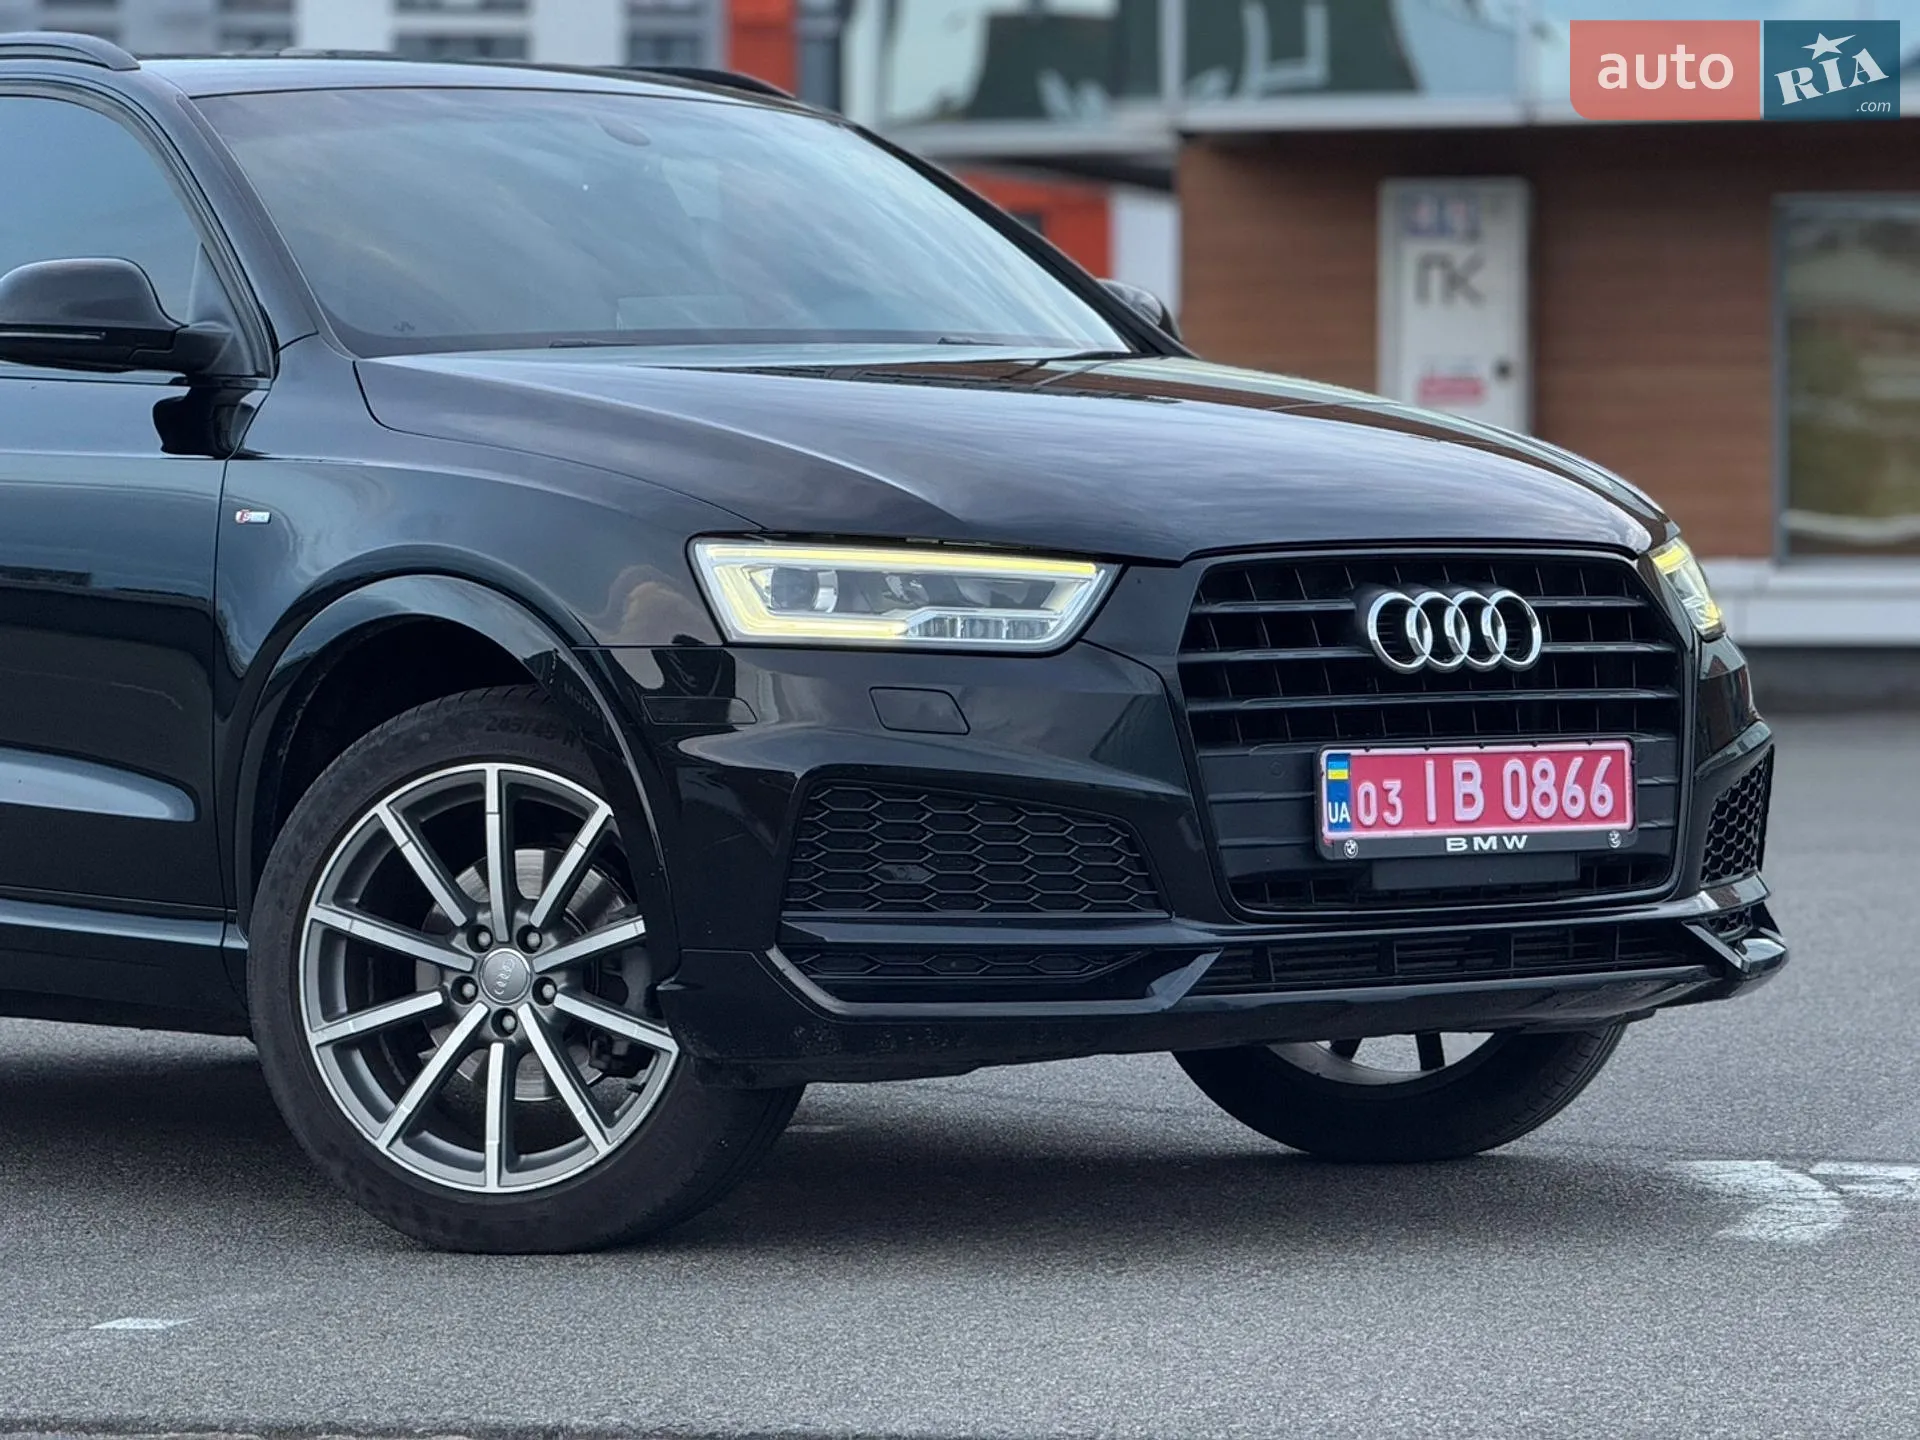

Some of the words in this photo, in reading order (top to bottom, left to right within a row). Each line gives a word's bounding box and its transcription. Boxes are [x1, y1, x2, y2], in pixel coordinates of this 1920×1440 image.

[1357, 779, 1402, 827] 03
[1502, 756, 1613, 820] 0866
[1328, 804, 1351, 823] UA
[1446, 835, 1528, 851] BMW
